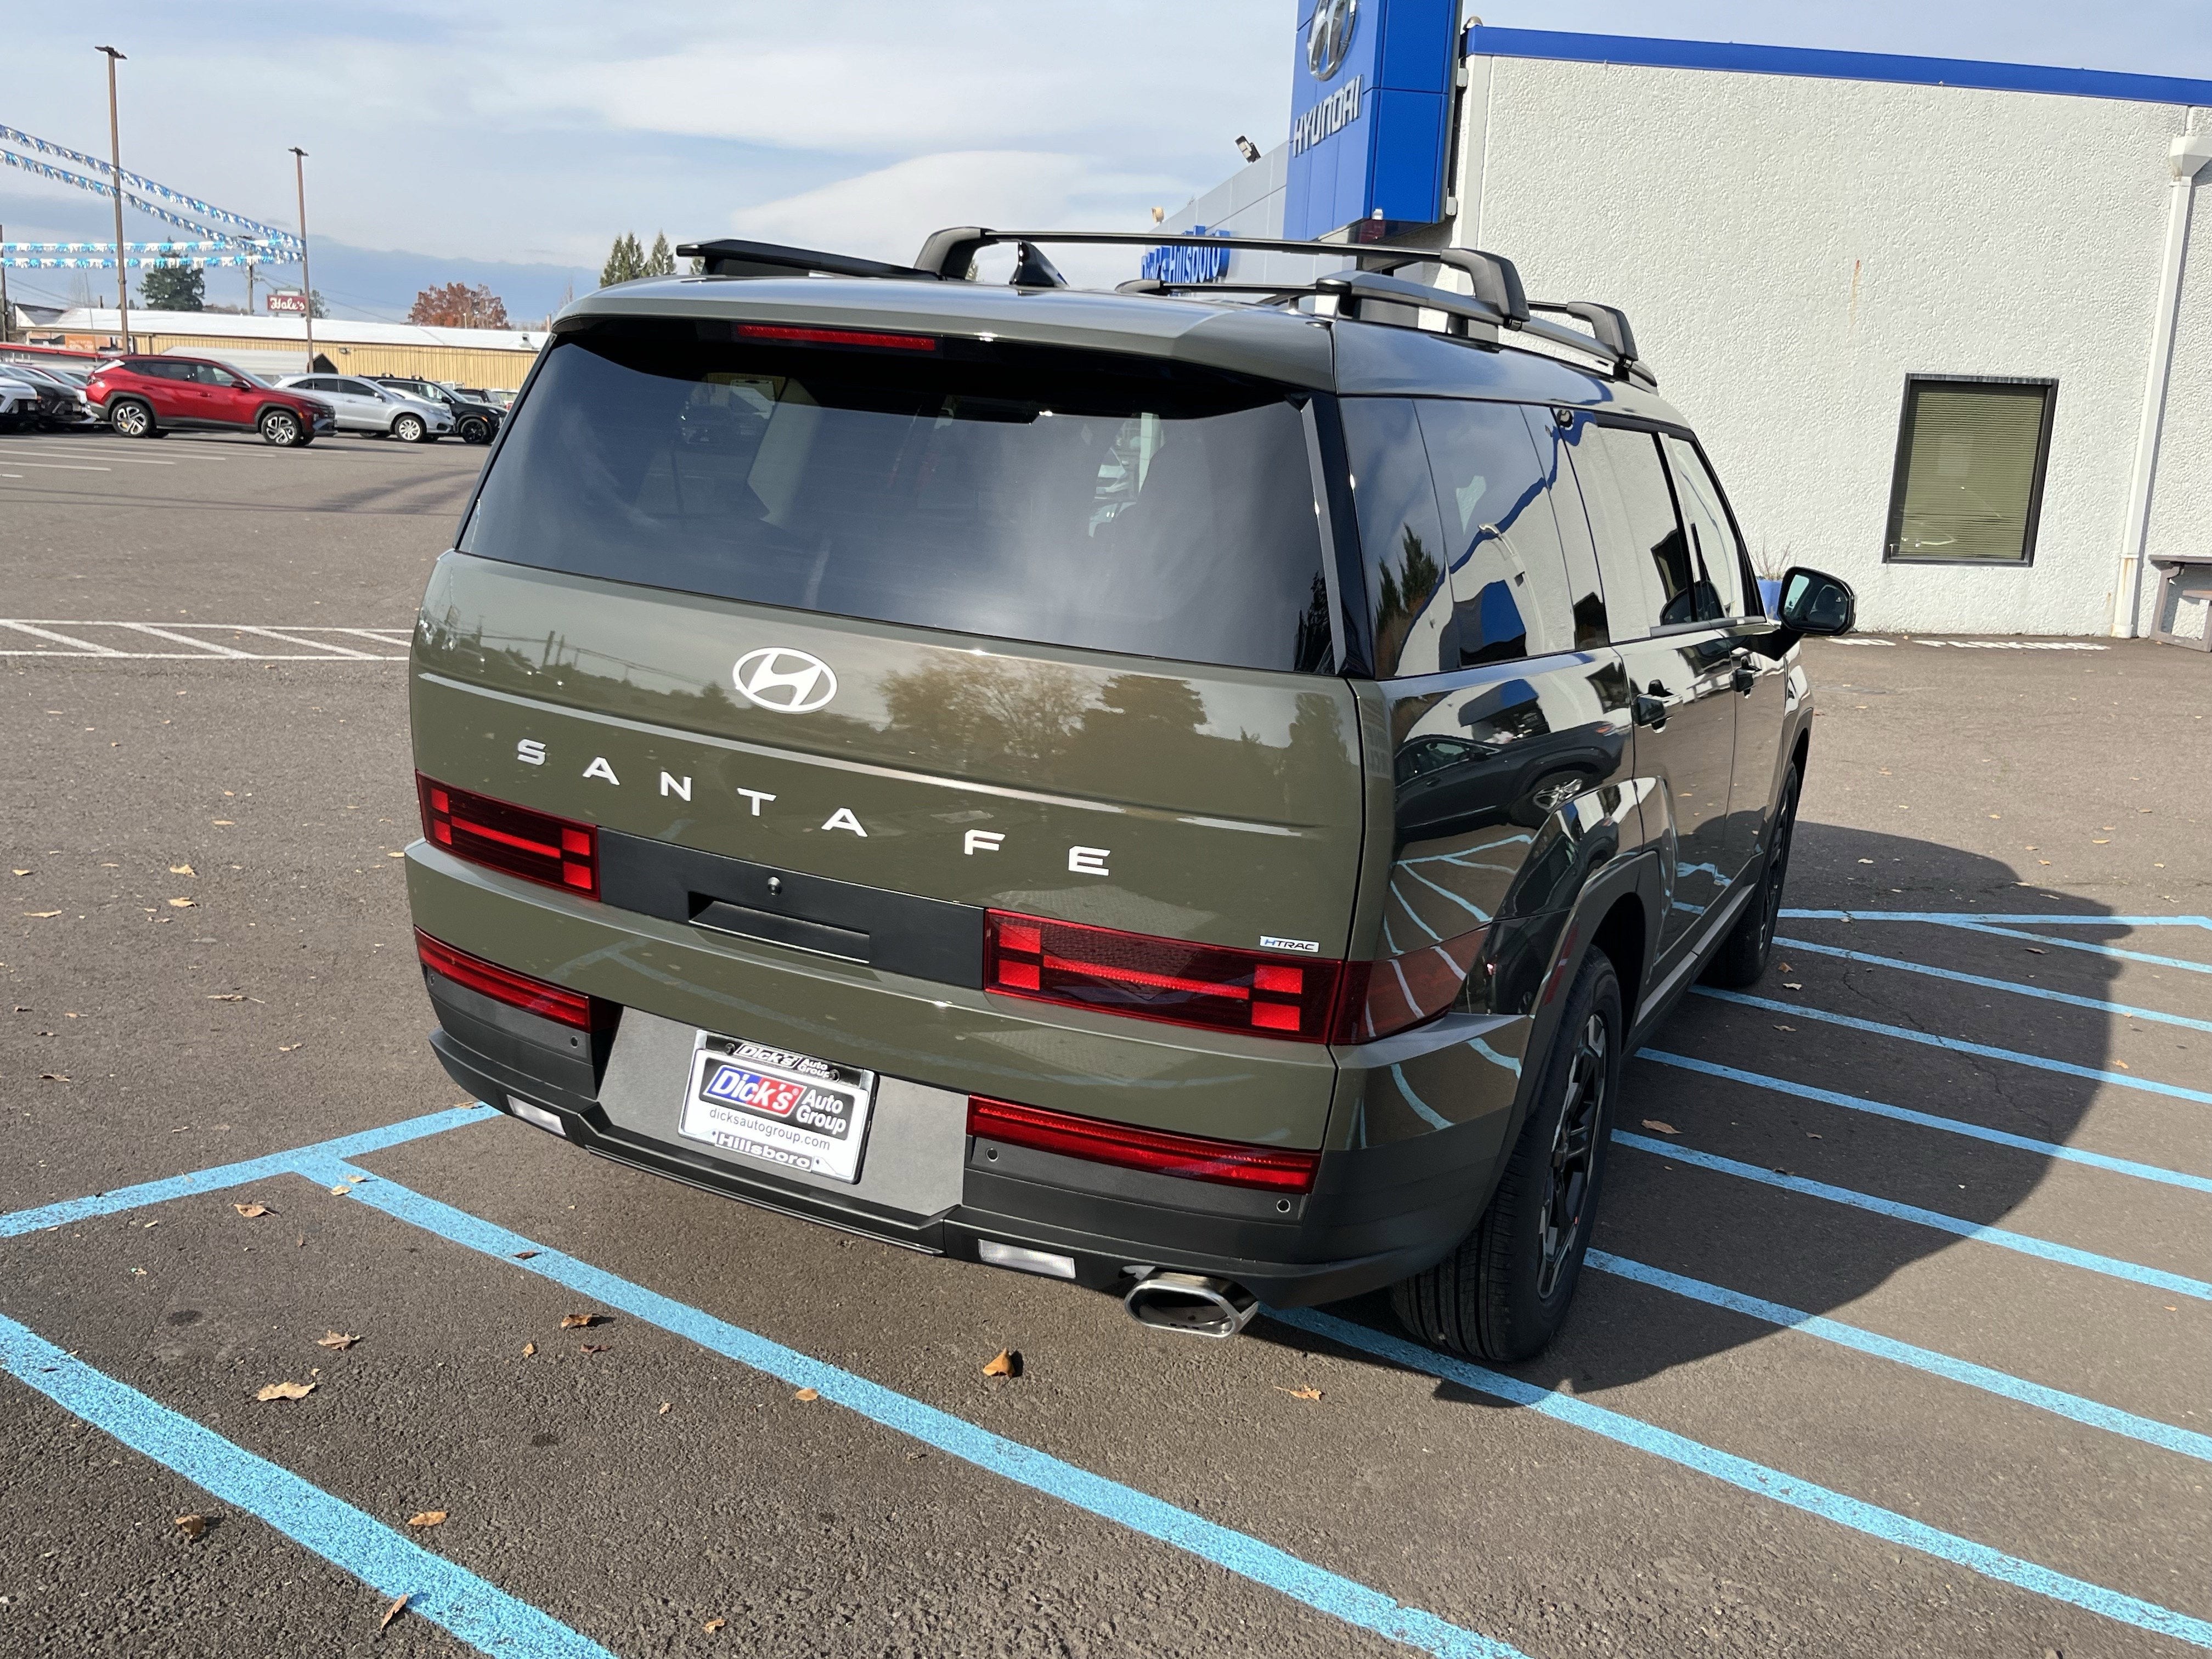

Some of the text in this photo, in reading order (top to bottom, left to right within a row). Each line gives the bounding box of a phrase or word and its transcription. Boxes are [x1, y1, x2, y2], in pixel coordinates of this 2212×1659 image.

[1294, 75, 1363, 157] HYUNDAI
[270, 297, 305, 311] Hale's
[517, 738, 1110, 876] SANTA FE
[1265, 939, 1314, 950] HTRAC
[741, 1045, 797, 1066] Dick's
[802, 1058, 828, 1070] Auto
[712, 1070, 793, 1111] Dick's
[802, 1089, 844, 1114] Auto
[710, 1108, 830, 1150] dicksautogroup.com
[796, 1105, 847, 1135] Group
[718, 1133, 810, 1169] Hillsboro
